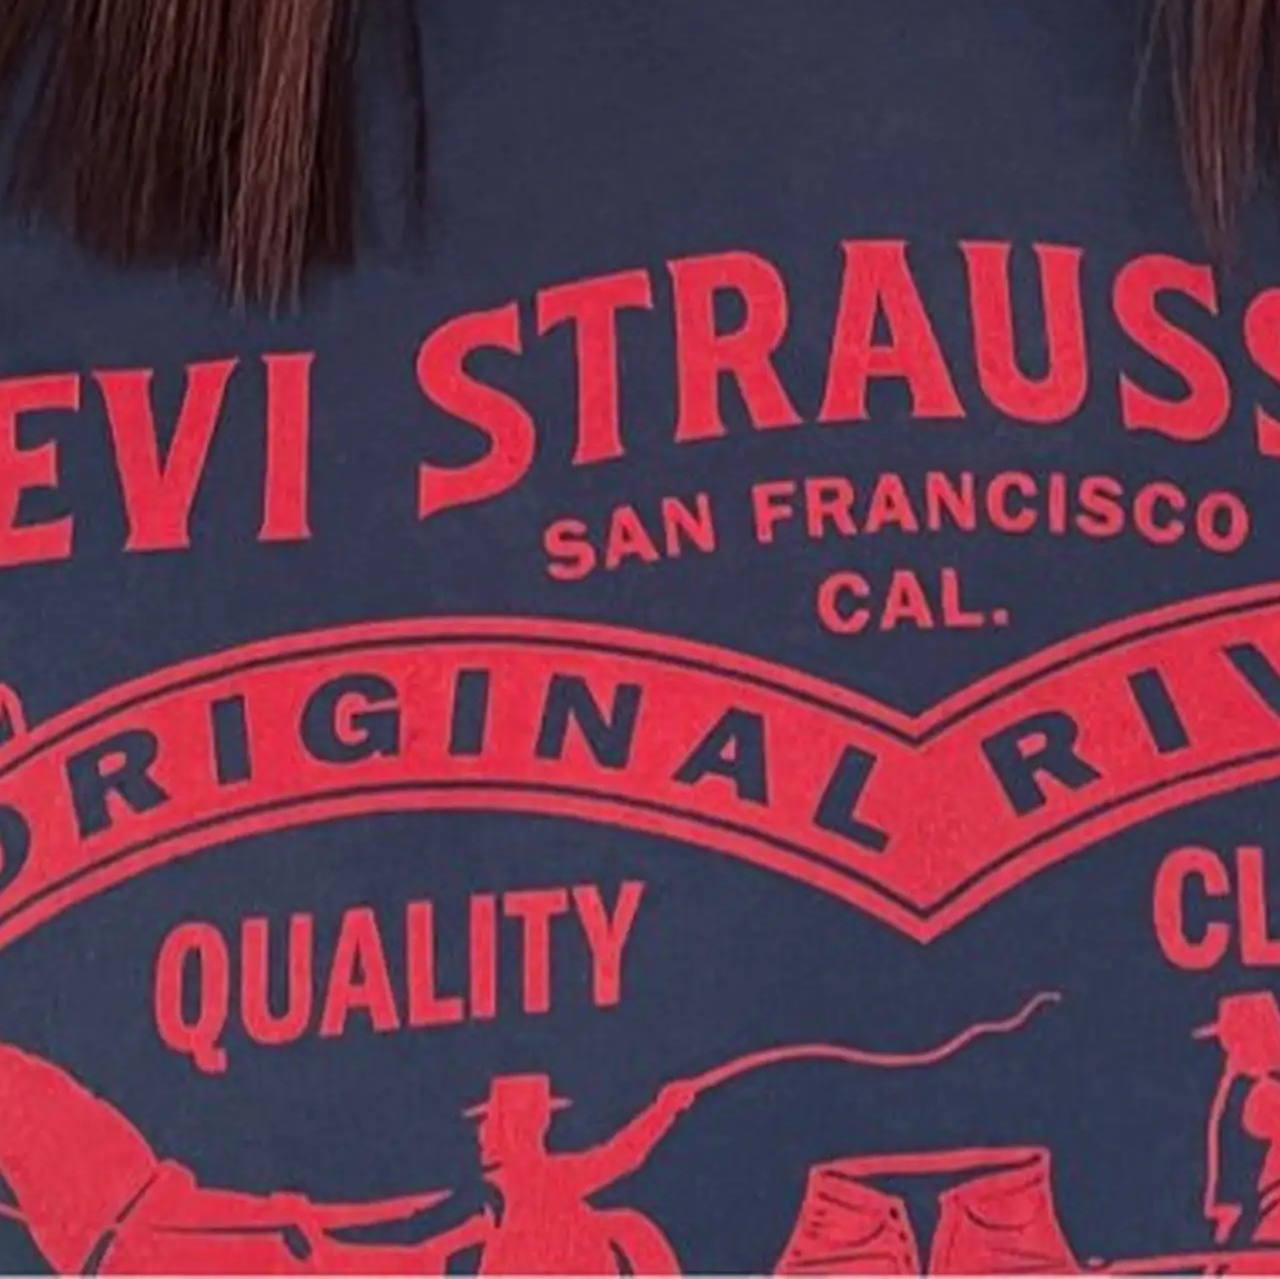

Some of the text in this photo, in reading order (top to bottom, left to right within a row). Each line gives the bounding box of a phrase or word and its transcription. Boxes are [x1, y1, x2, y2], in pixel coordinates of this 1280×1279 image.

[543, 470, 1250, 582] SAN FRANCISCO
[815, 571, 1010, 635] CAL.
[154, 881, 644, 1072] QUALITY
